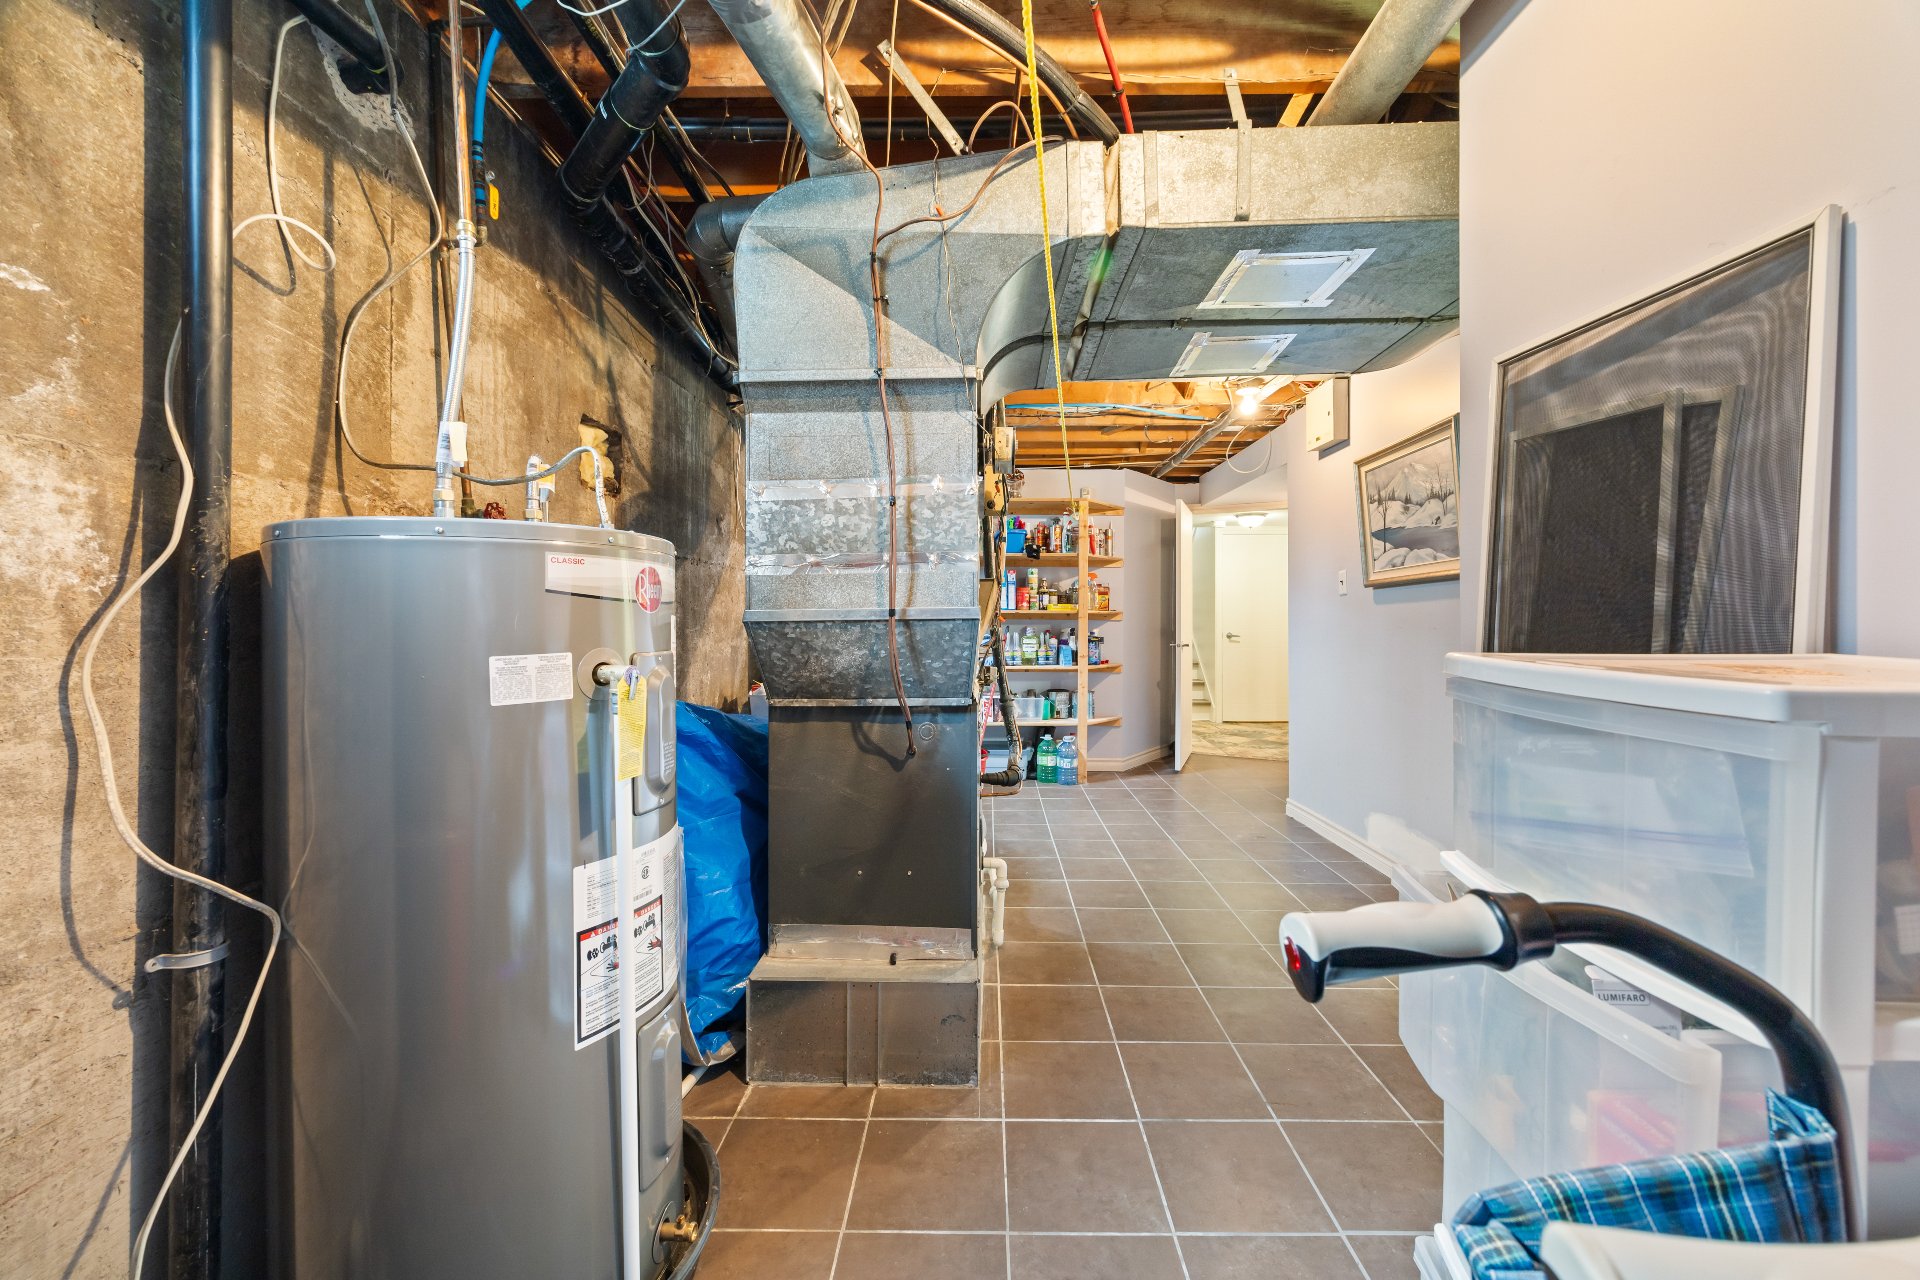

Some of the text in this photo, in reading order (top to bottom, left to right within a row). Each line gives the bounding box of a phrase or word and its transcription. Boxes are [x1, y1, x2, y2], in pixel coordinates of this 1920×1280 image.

[550, 556, 586, 565] CLASSIC
[637, 567, 662, 605] Rheem
[1598, 993, 1646, 1002] LUMIFARO
